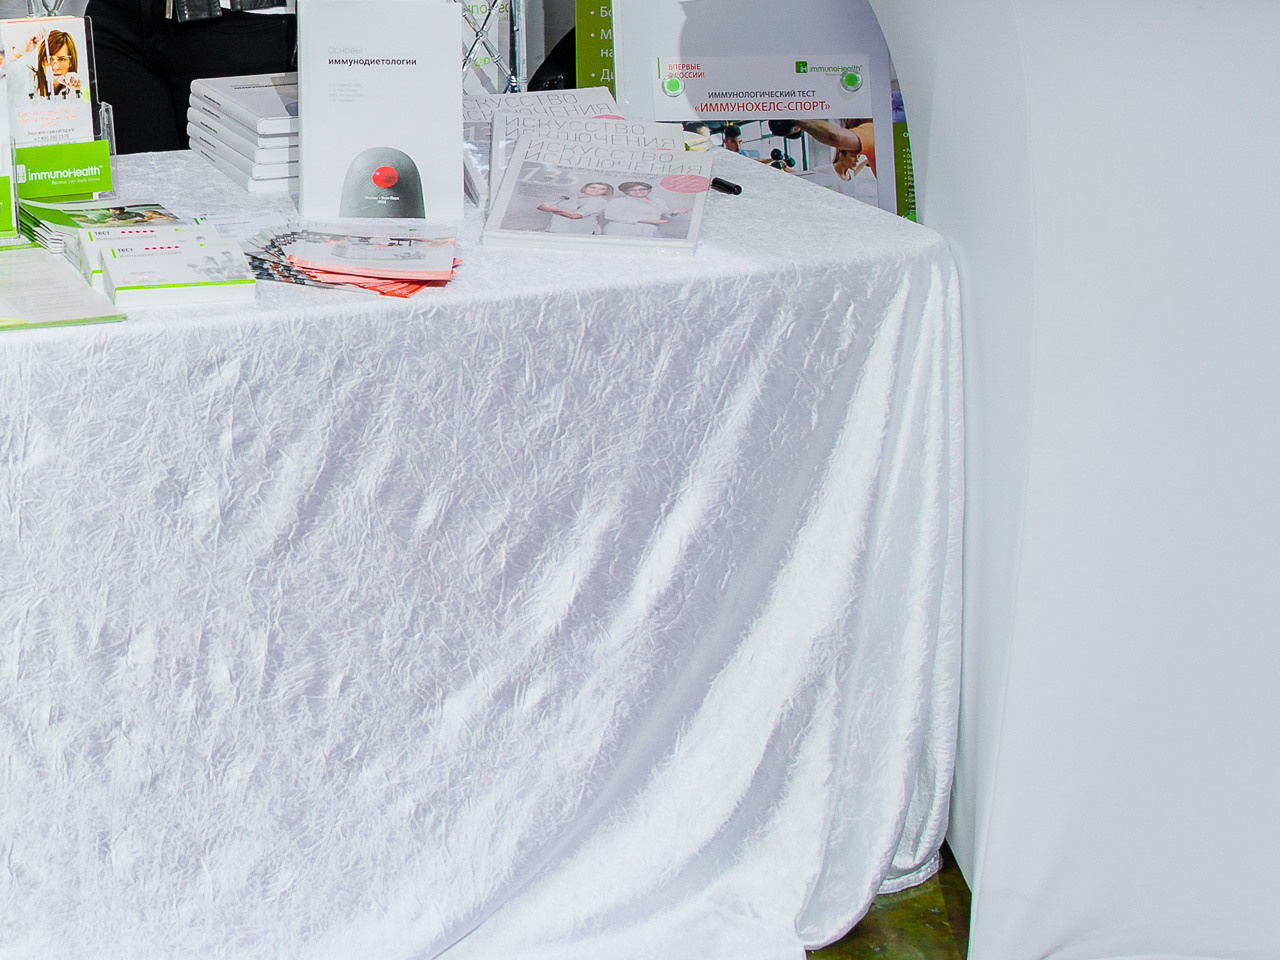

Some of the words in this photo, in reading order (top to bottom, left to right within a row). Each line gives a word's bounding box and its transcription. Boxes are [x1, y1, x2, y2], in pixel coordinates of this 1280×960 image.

[328, 46, 362, 54] Основы
[328, 58, 417, 66] иммунодиетологии
[463, 93, 577, 110] СКУССТВО
[708, 91, 795, 99] ИММУНОЛОГИЧЕСКИЙ
[695, 101, 830, 112] «ИММУНОХЕЛС-СПОРТ»
[505, 116, 645, 135] ИСКУССТВО
[528, 140, 674, 163] ИСКУССТВО
[524, 151, 702, 175] ИСКЛЮЧЕНИЯ
[28, 166, 100, 181] immunoHealth
